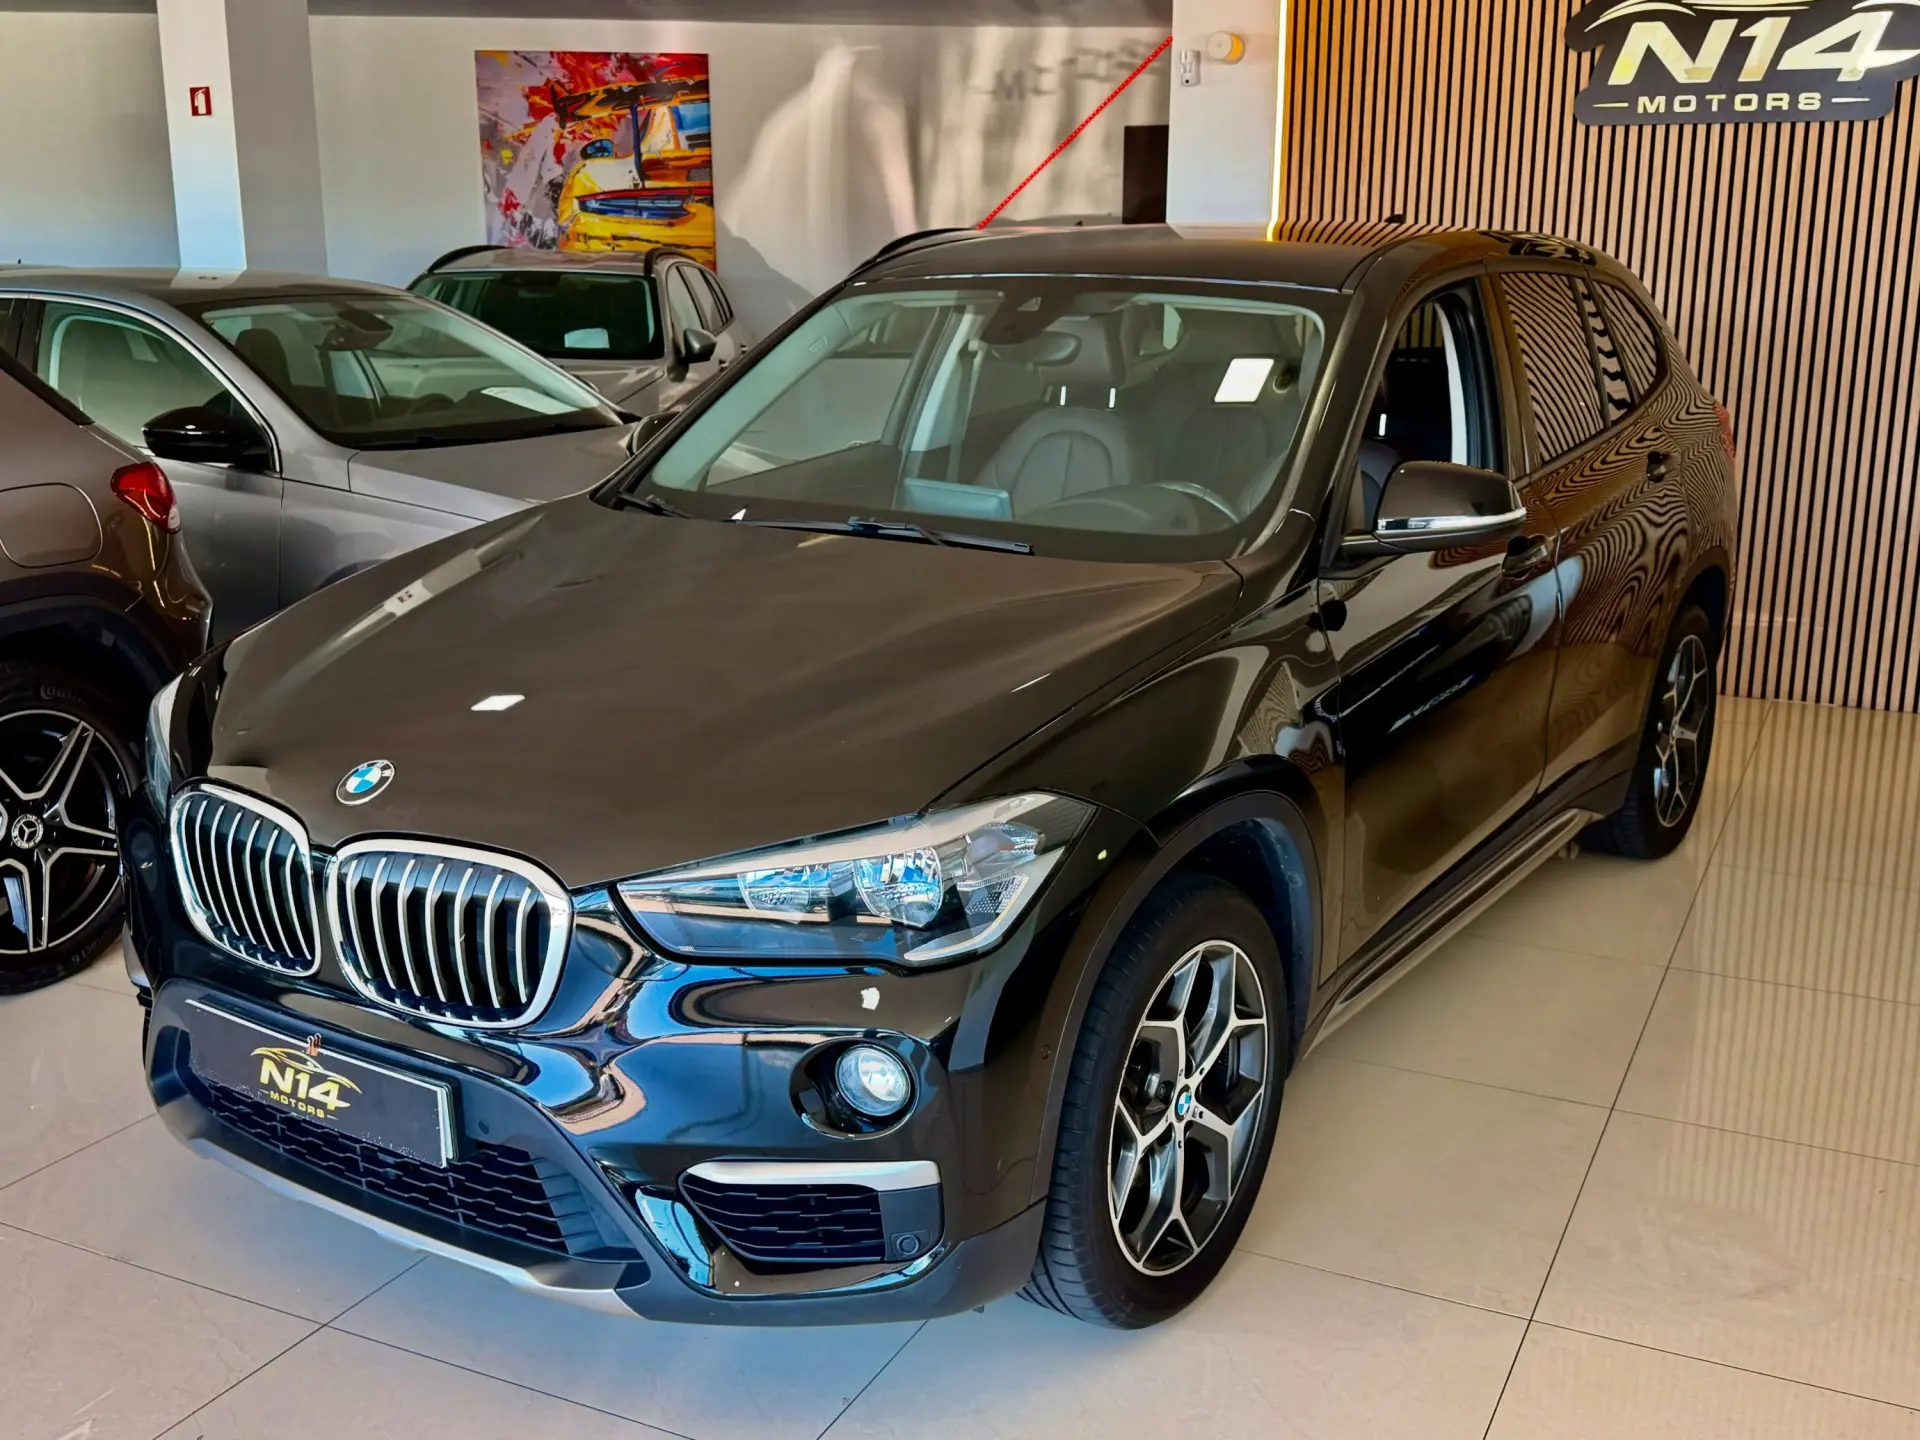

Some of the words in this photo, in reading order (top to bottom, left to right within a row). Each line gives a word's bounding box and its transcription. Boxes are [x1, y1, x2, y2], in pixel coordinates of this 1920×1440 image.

[1607, 11, 1912, 85] N14
[1637, 92, 1821, 114] MOTORS
[260, 1057, 350, 1111] N14
[270, 1090, 325, 1118] MOTORS
